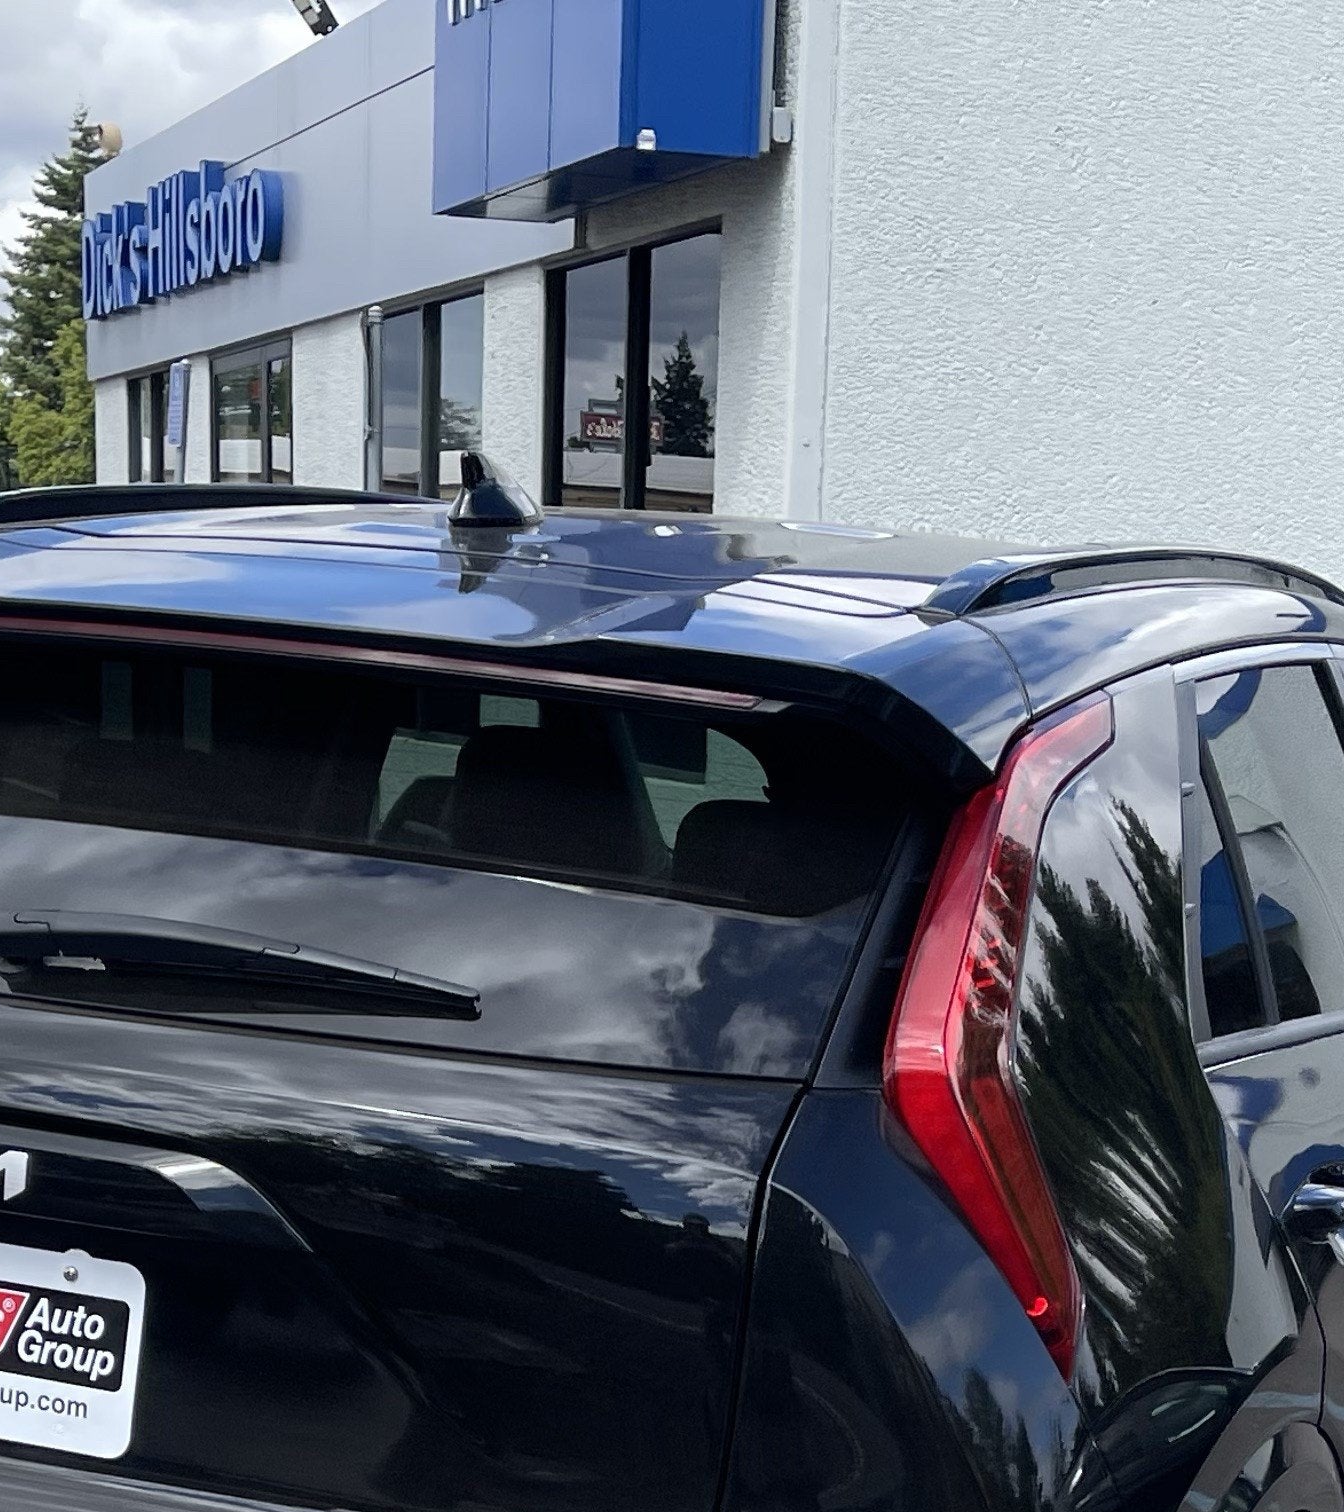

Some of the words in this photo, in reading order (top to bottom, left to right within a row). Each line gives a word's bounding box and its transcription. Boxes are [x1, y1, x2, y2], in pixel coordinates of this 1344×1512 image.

[81, 200, 142, 320] Dick's
[147, 159, 266, 298] Hillsboro
[25, 1297, 106, 1340] Auto
[17, 1330, 116, 1381] Group
